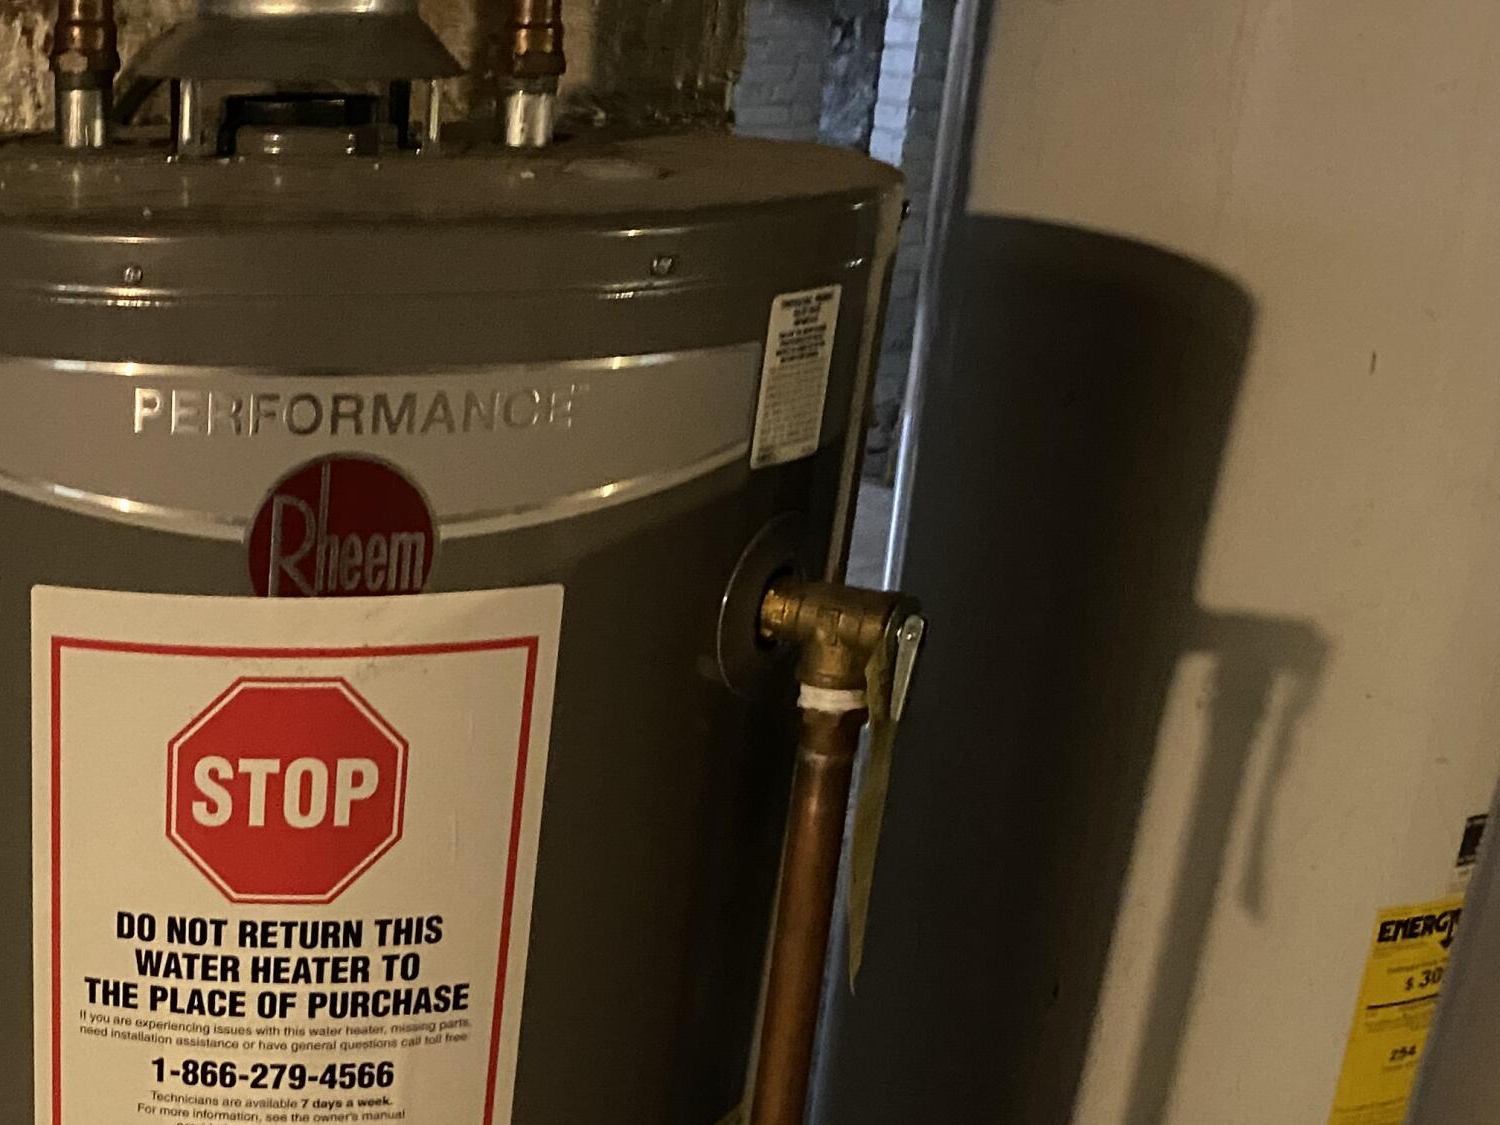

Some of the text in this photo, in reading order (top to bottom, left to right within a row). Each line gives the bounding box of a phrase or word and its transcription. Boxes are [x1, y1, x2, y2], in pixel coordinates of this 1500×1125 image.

[134, 384, 576, 437] PERFORMANCE
[266, 461, 427, 598] Rheem
[191, 755, 380, 830] STOP
[117, 911, 443, 949] DO NOT RETURN THIS
[1377, 907, 1461, 949] ENERGY
[135, 948, 420, 984] WATER HEATER TO
[84, 976, 470, 1019] THE PLACE OF PURCHASE
[80, 1025, 108, 1037] need
[111, 1029, 172, 1045] installation
[176, 1037, 239, 1050] assistance
[243, 1041, 254, 1049] or
[258, 1040, 287, 1050] have
[291, 1041, 336, 1052] general
[340, 1040, 397, 1051] questions
[401, 1037, 421, 1047] call
[425, 1034, 442, 1044] toll
[90, 1013, 110, 1024] you
[113, 1017, 132, 1026] are
[135, 1019, 211, 1035] experiencing
[214, 1025, 251, 1036] issues
[255, 1027, 280, 1036] with
[284, 1026, 305, 1036] this
[309, 1027, 341, 1036] water
[391, 1021, 436, 1034] missing
[151, 1057, 394, 1090] 1-866-279-4566
[137, 1102, 156, 1114] For
[160, 1107, 189, 1117] more
[266, 1114, 288, 1122] see
[291, 1112, 310, 1122] the
[313, 1111, 358, 1122] owner's
[362, 1110, 405, 1121] manual
[150, 1090, 393, 1110] Technicians are available 7 days a week.
